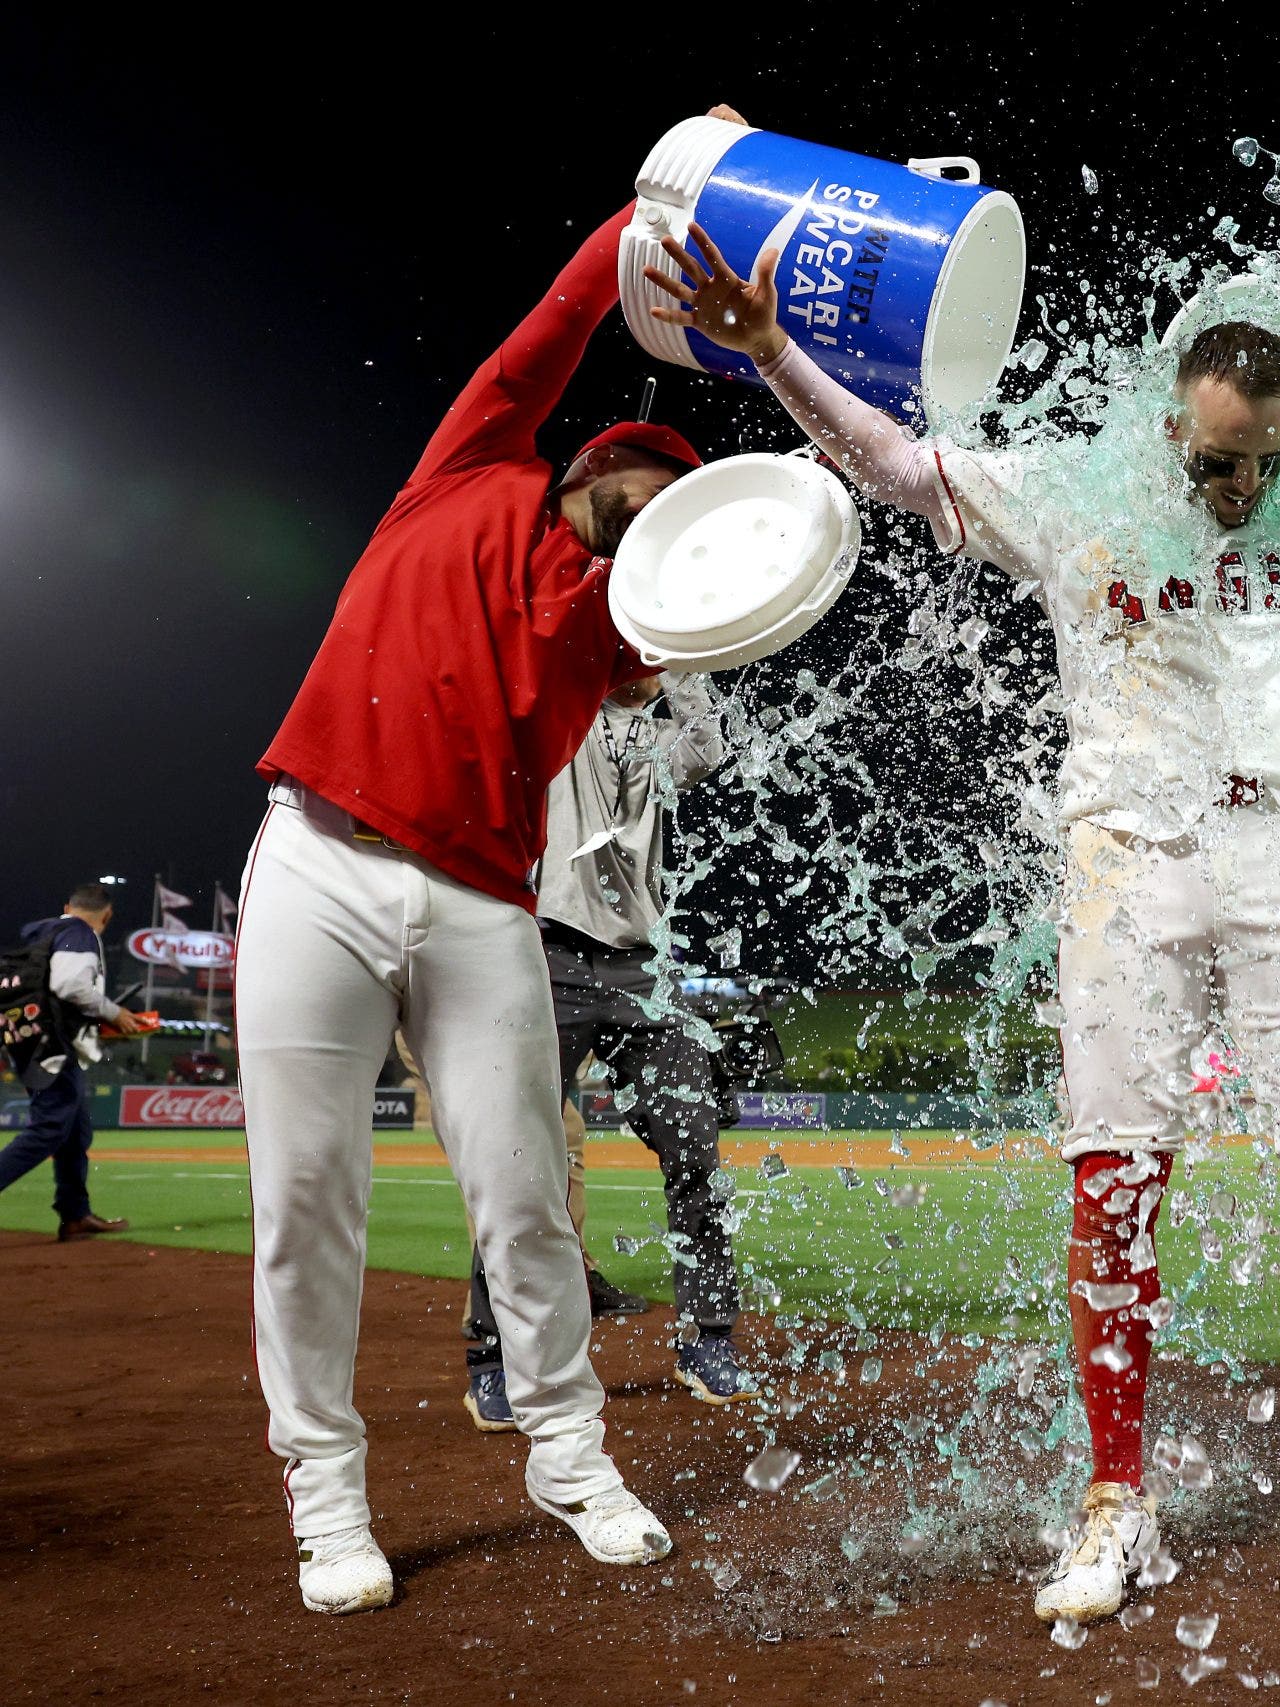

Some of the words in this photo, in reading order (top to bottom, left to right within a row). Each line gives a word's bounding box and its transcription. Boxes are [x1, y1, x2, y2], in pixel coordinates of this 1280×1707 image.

[788, 183, 851, 326] SWEAT
[813, 189, 880, 346] POCARI
[845, 226, 890, 325] WATER
